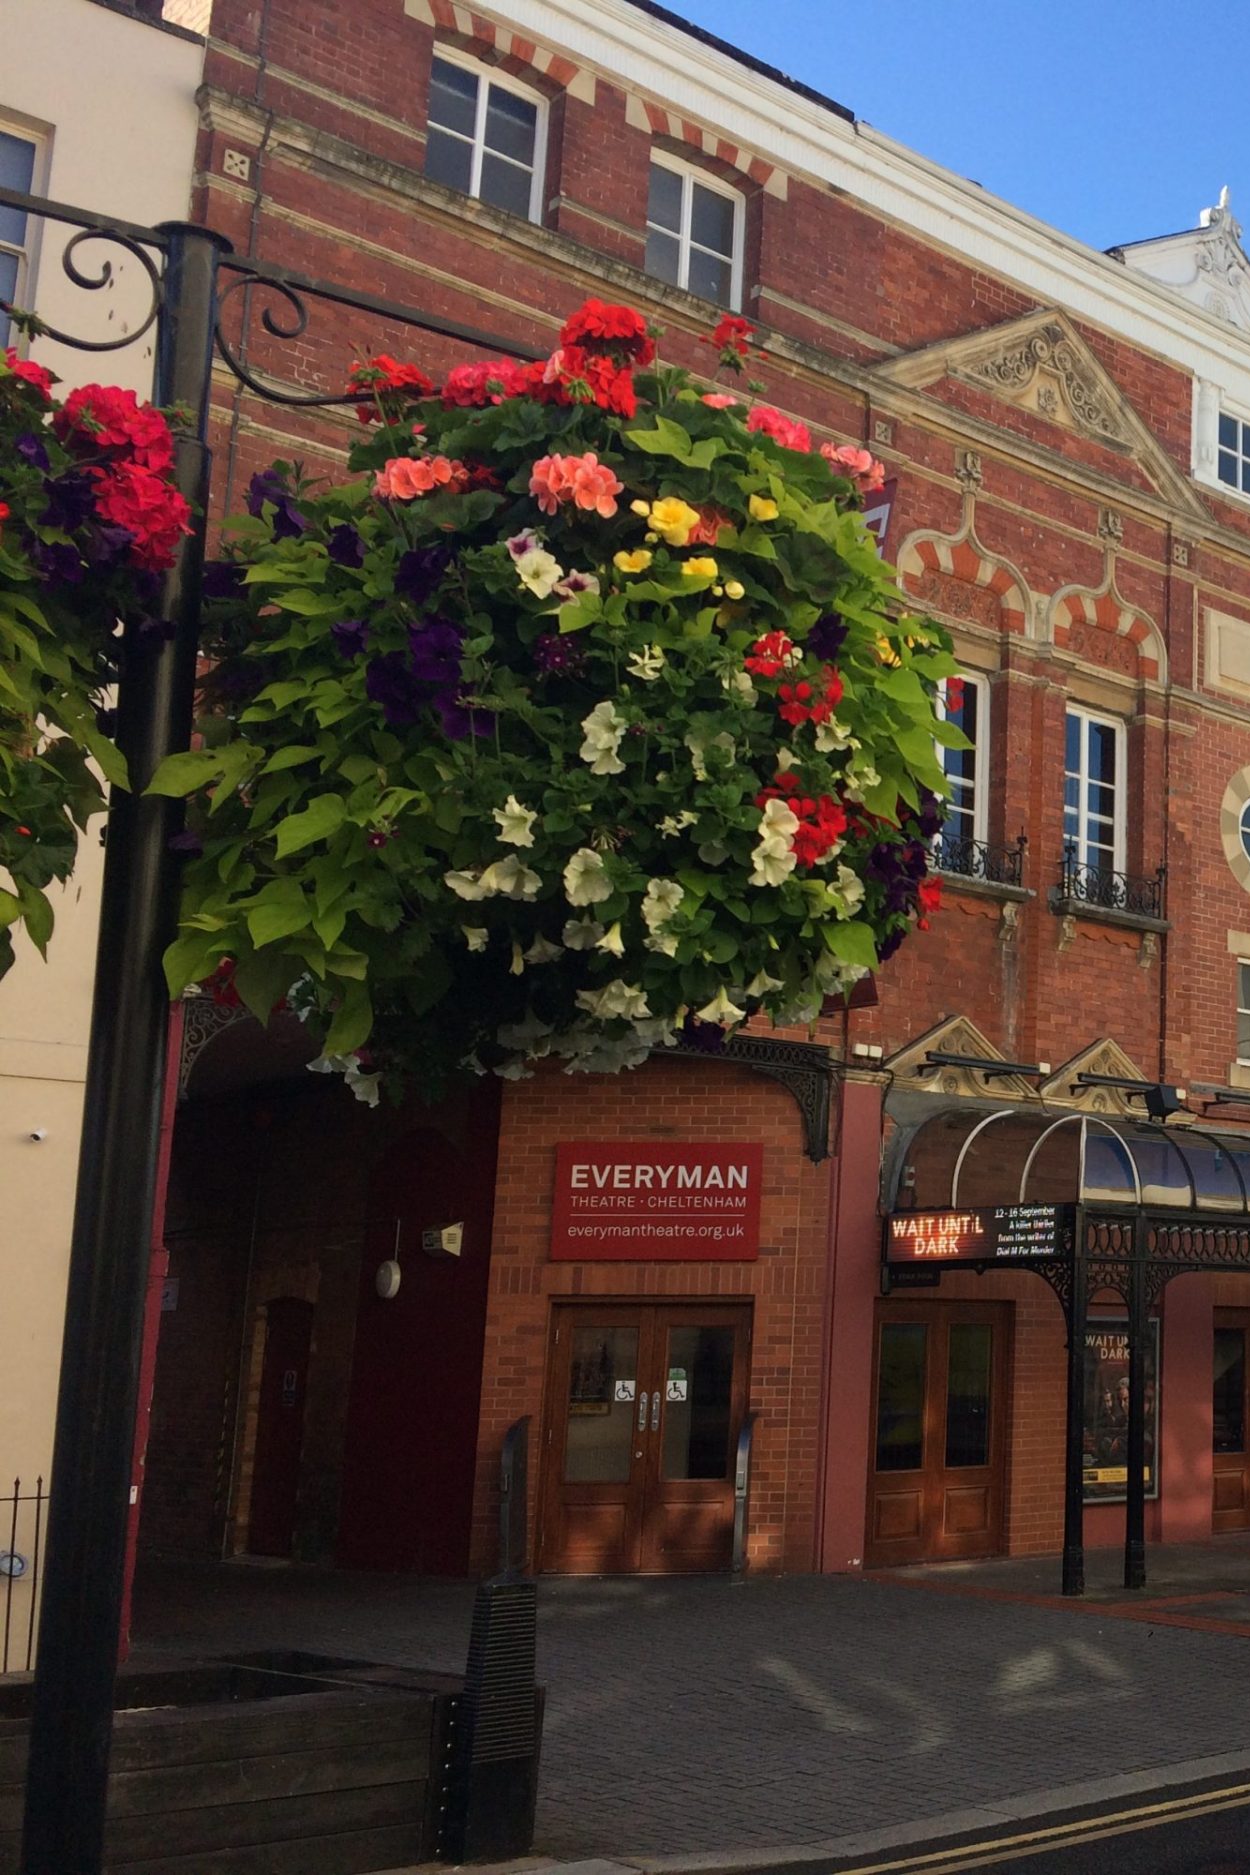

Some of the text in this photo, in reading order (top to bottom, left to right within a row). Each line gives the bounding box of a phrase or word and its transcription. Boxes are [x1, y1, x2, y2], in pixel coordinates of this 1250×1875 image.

[571, 1165, 748, 1189] EVERYMAN
[570, 1195, 747, 1208] THEATRE CHELTENHAM
[1019, 1206, 1055, 1218] September
[567, 1223, 745, 1241] everymantheatre.org.uk
[892, 1217, 935, 1238] WAIT
[914, 1236, 959, 1255] DARK
[1084, 1335, 1114, 1347] WAIT
[1100, 1347, 1130, 1360] DARK
